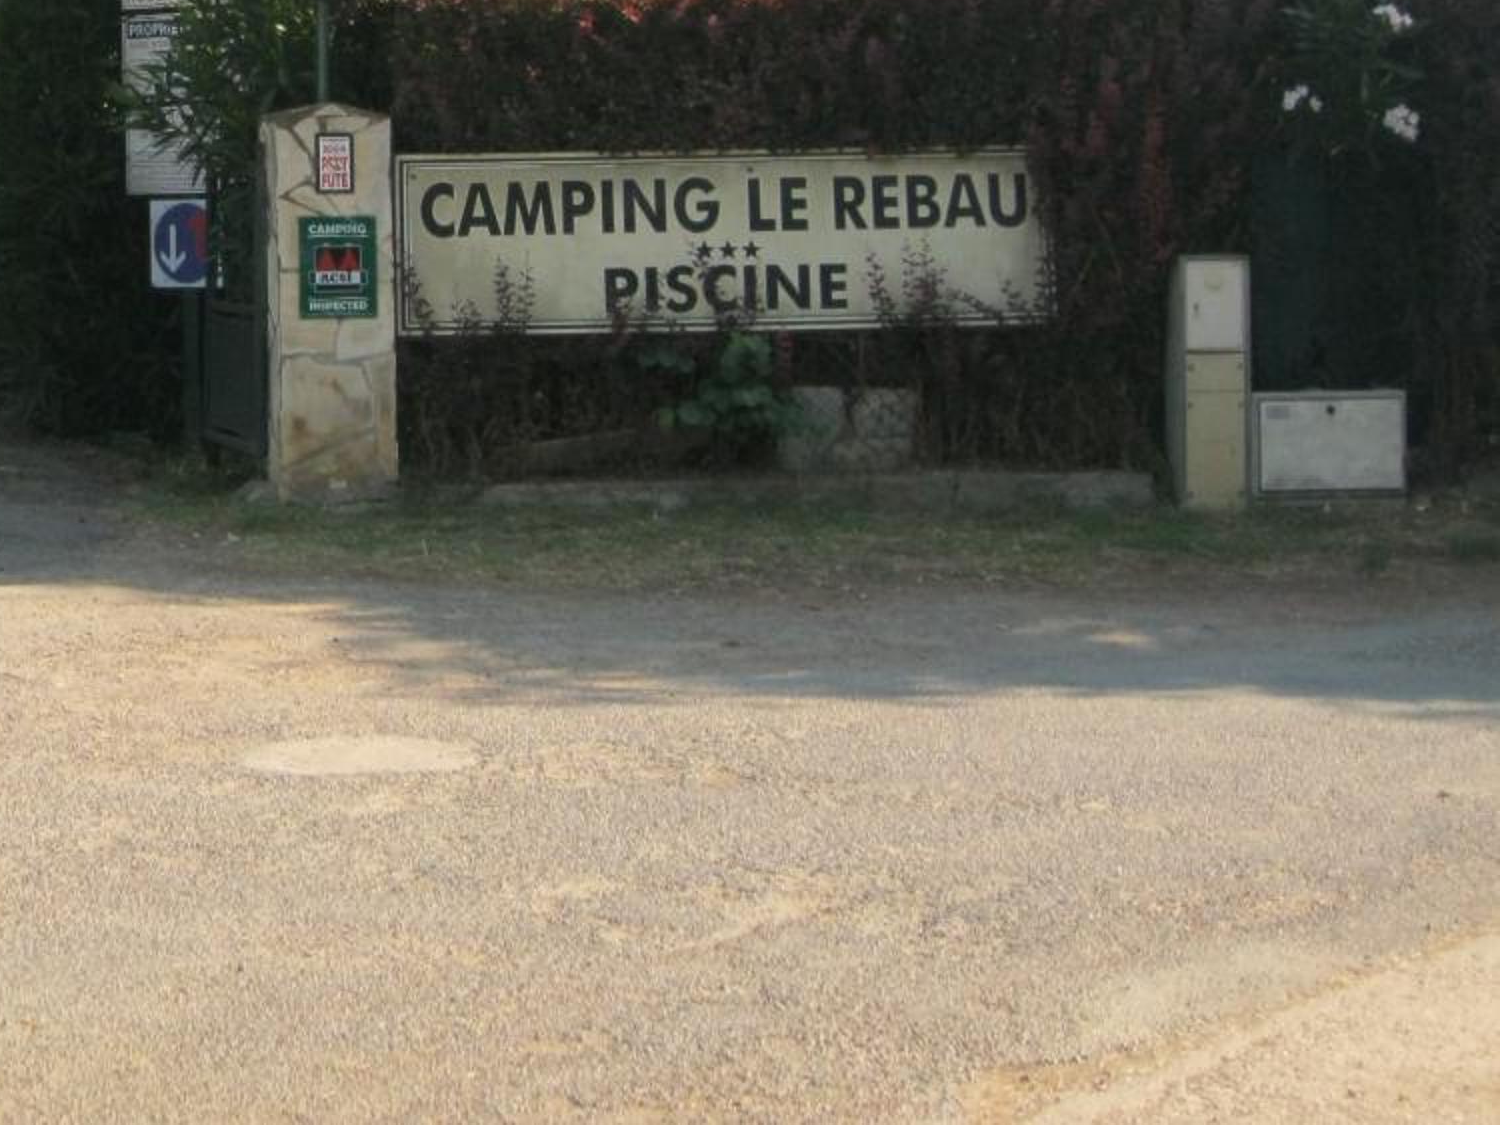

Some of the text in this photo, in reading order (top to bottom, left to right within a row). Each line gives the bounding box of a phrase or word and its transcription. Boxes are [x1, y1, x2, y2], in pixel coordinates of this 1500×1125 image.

[420, 173, 1028, 238] CAMPING LE REBAU
[308, 223, 367, 235] CAMPING
[605, 263, 847, 315] PISCINE
[309, 301, 368, 311] INSPECTED
